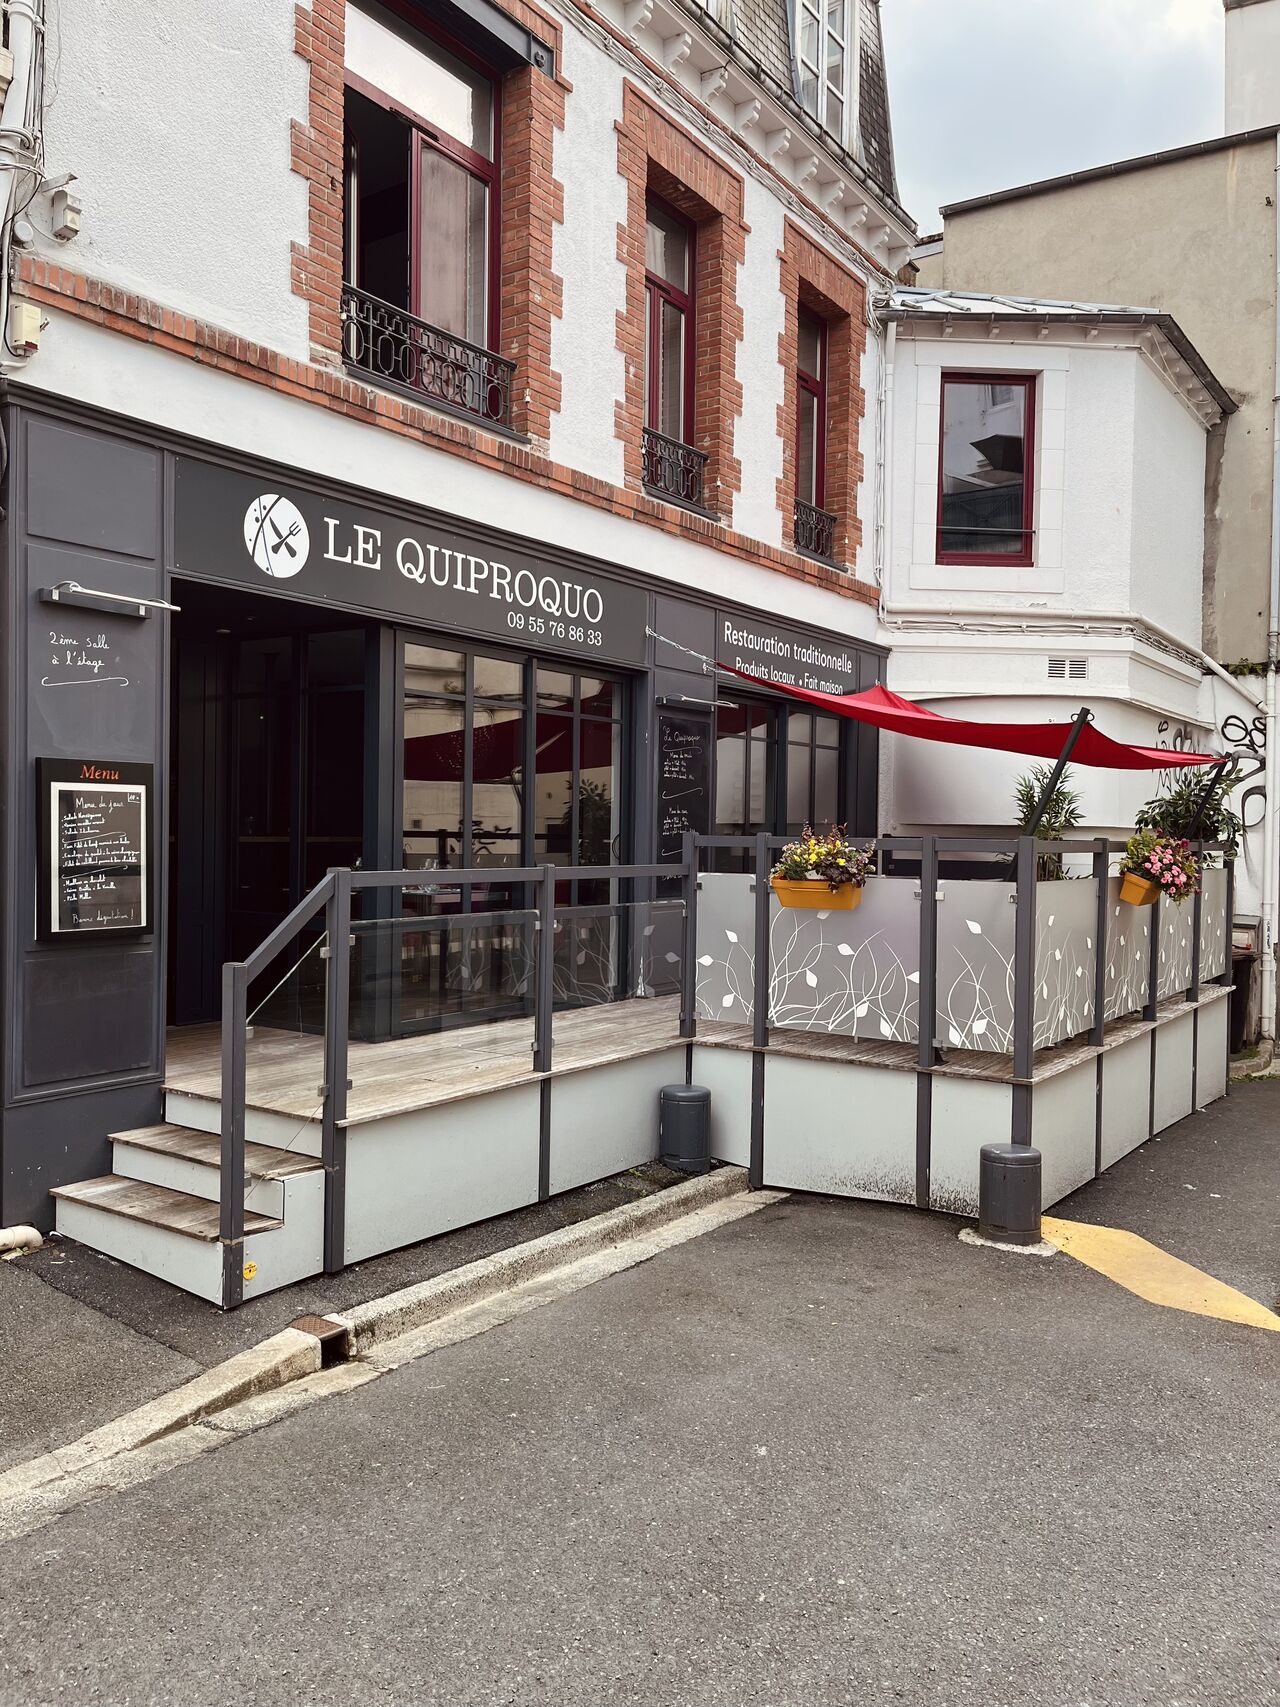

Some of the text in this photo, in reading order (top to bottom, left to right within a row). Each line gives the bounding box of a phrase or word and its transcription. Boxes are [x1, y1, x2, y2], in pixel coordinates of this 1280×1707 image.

[323, 516, 604, 623] LE QUIPROQUO
[49, 631, 79, 645] 2ème
[507, 611, 602, 646] 09 55 76 86 33
[51, 650, 105, 673] à l'étage
[724, 621, 852, 674] Restauration traditionnelle
[735, 656, 844, 696] Produits locaux Fait maison
[80, 764, 120, 780] Menu
